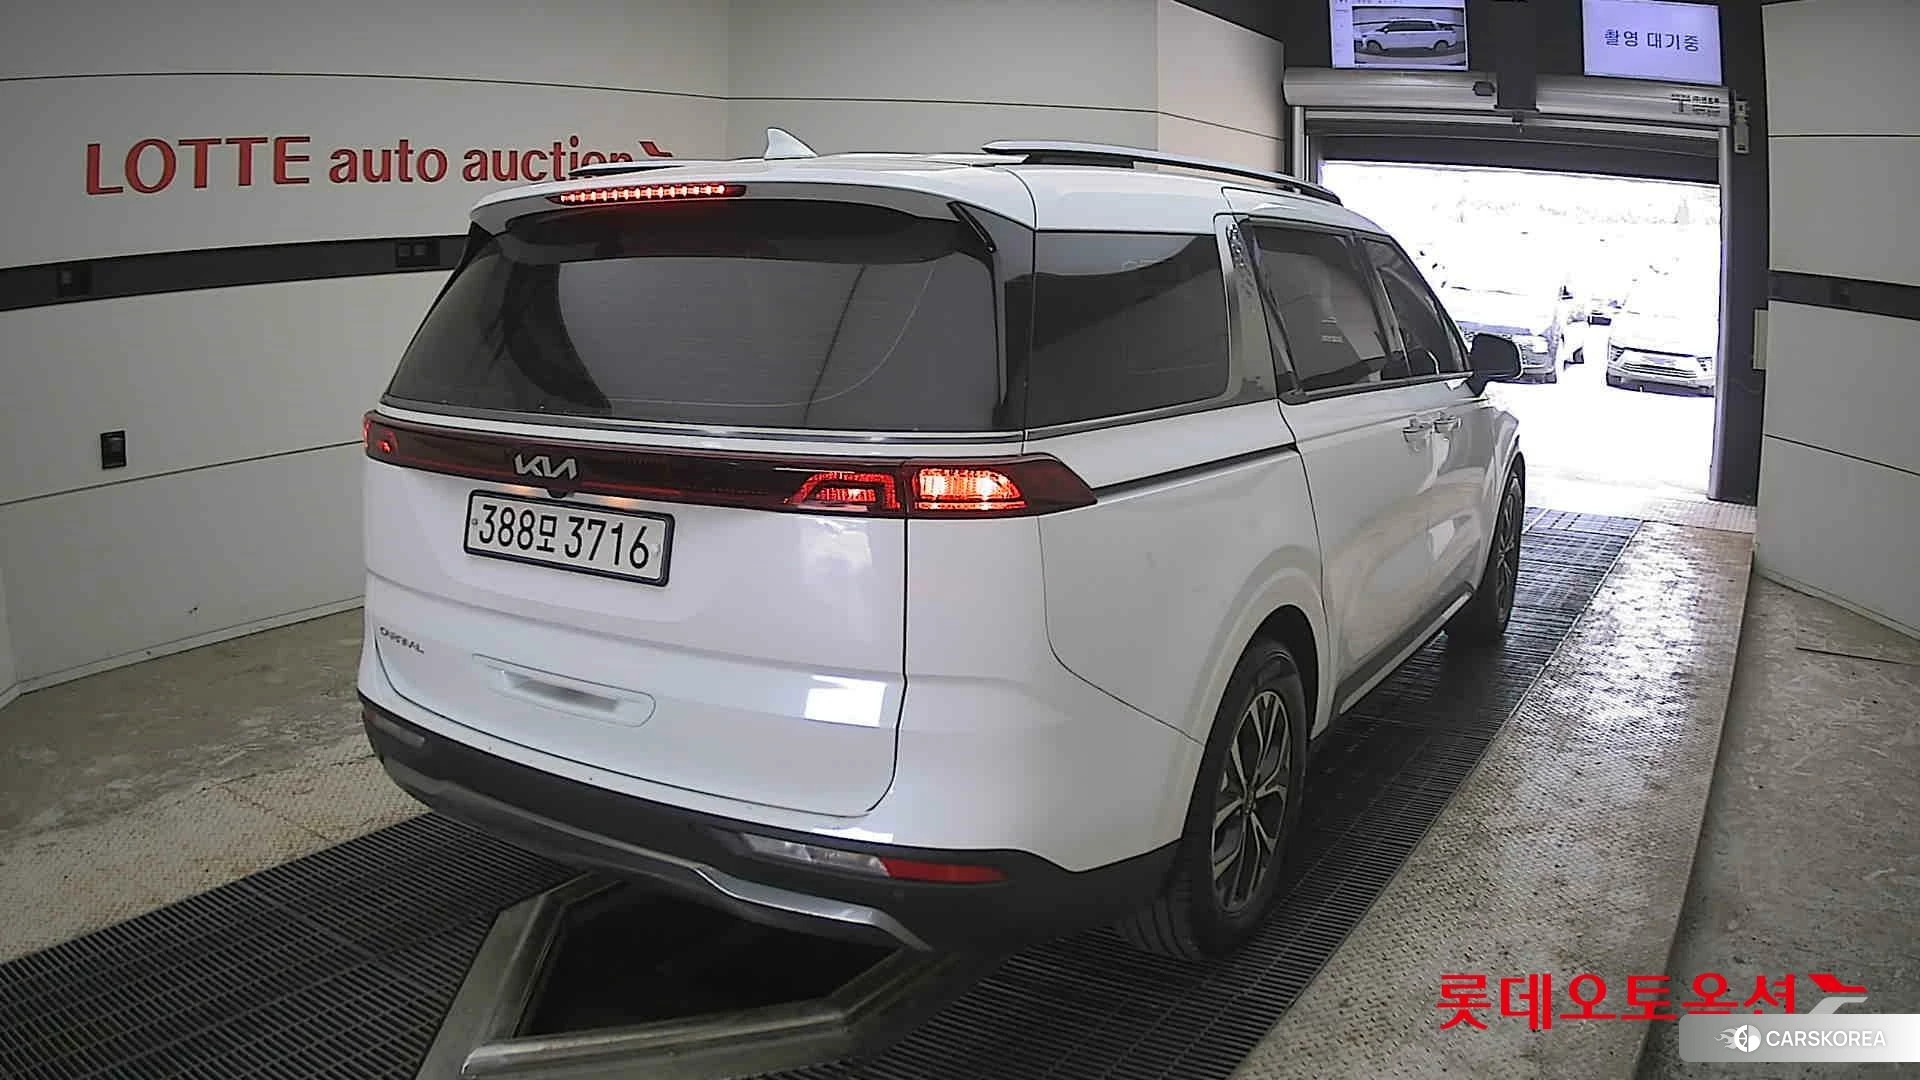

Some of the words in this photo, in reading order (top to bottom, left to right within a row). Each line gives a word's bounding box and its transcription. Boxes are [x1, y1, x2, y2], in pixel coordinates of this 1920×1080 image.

[1647, 32, 1699, 52] 대기중
[86, 136, 310, 195] LOTTE
[328, 139, 449, 183] auto
